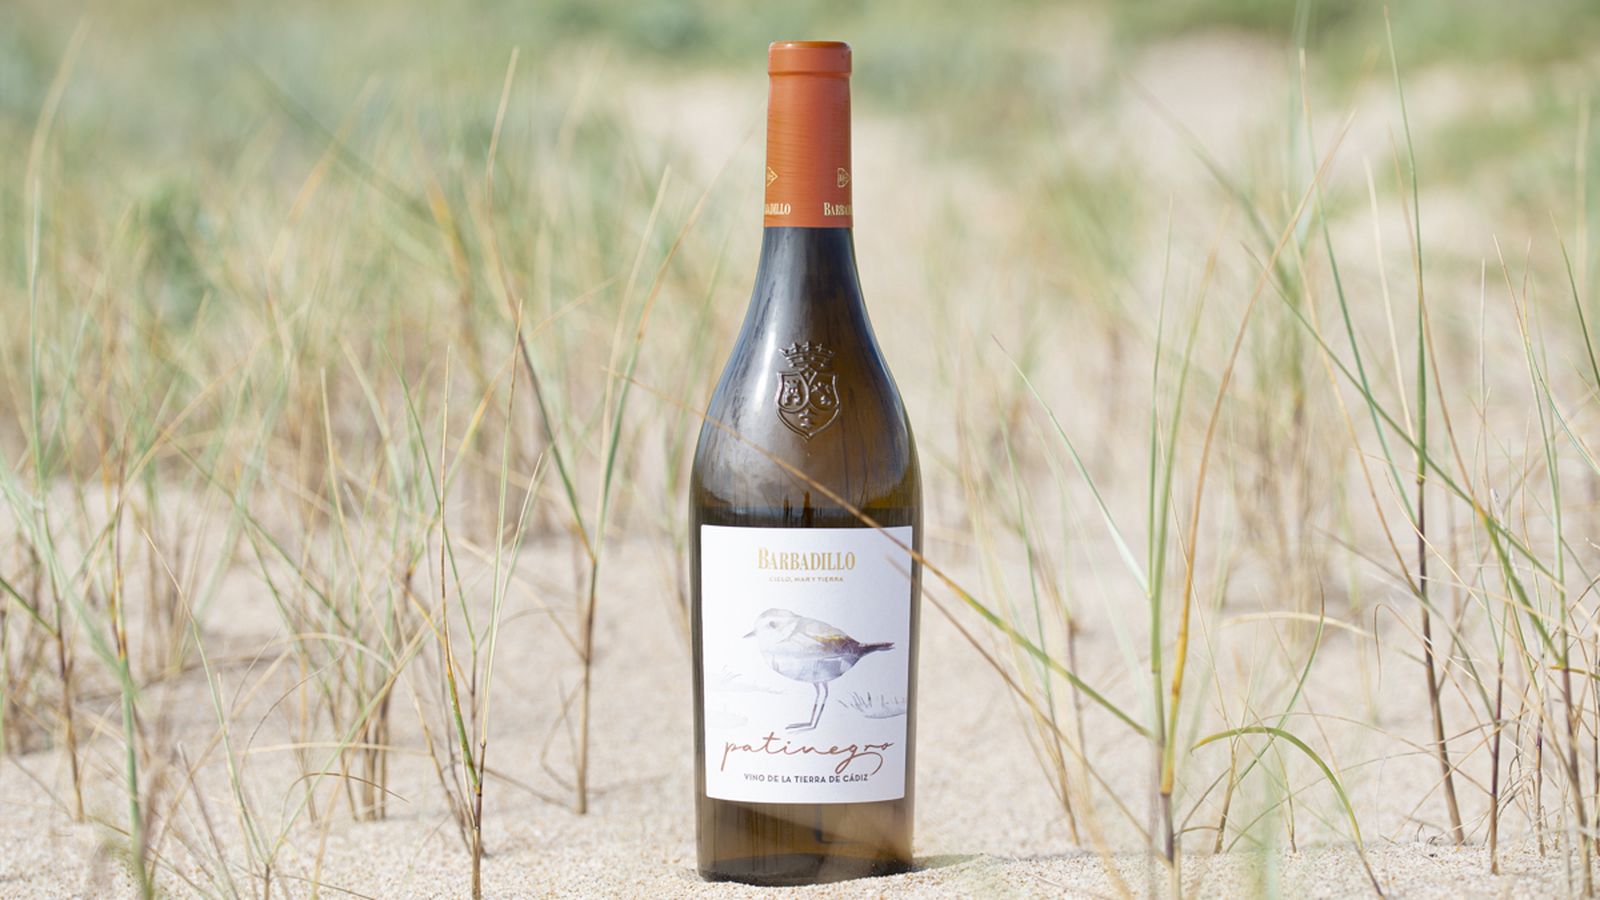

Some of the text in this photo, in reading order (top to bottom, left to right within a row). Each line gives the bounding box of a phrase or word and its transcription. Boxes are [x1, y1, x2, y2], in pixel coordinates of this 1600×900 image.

[757, 547, 856, 571] BARBADILLO
[720, 731, 895, 776] patinegro
[744, 772, 869, 784] VINO DE LA TIERRA DE CÁDIZ
